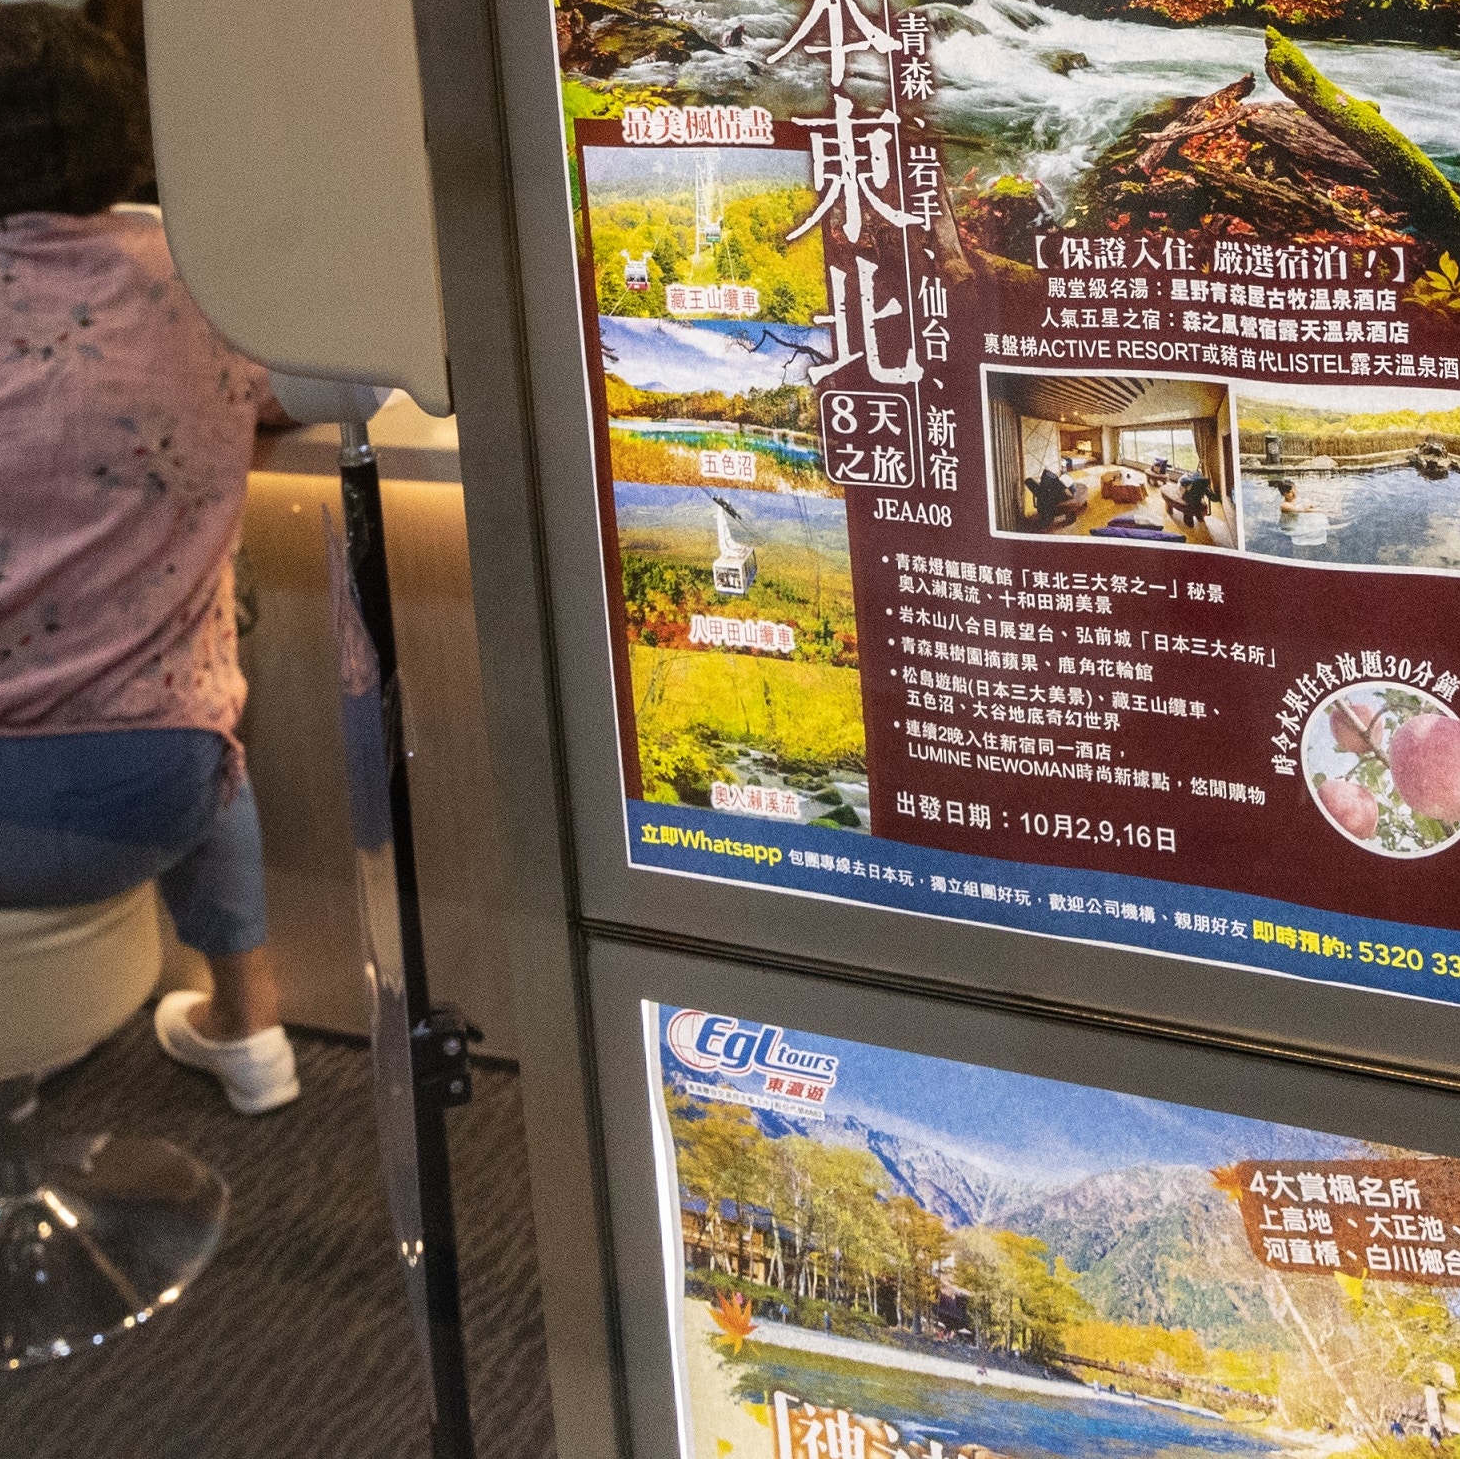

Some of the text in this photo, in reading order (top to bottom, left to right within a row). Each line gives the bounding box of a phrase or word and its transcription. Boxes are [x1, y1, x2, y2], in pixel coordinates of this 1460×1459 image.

[669, 287, 758, 313] 藏王山纜車
[831, 395, 902, 436] 8天
[703, 452, 755, 478] 五色沼
[835, 443, 908, 484] 之旅
[873, 497, 952, 527] JEAA08
[692, 618, 794, 650] 八甲田山纜車
[908, 742, 972, 768] LUMINE
[640, 822, 783, 866] 立即Whatsapp
[1358, 941, 1424, 971] 5320
[778, 1043, 836, 1074] tours
[765, 1076, 826, 1103] 東瀛遊
[1249, 1169, 1423, 1211] 4大賞楓名所
